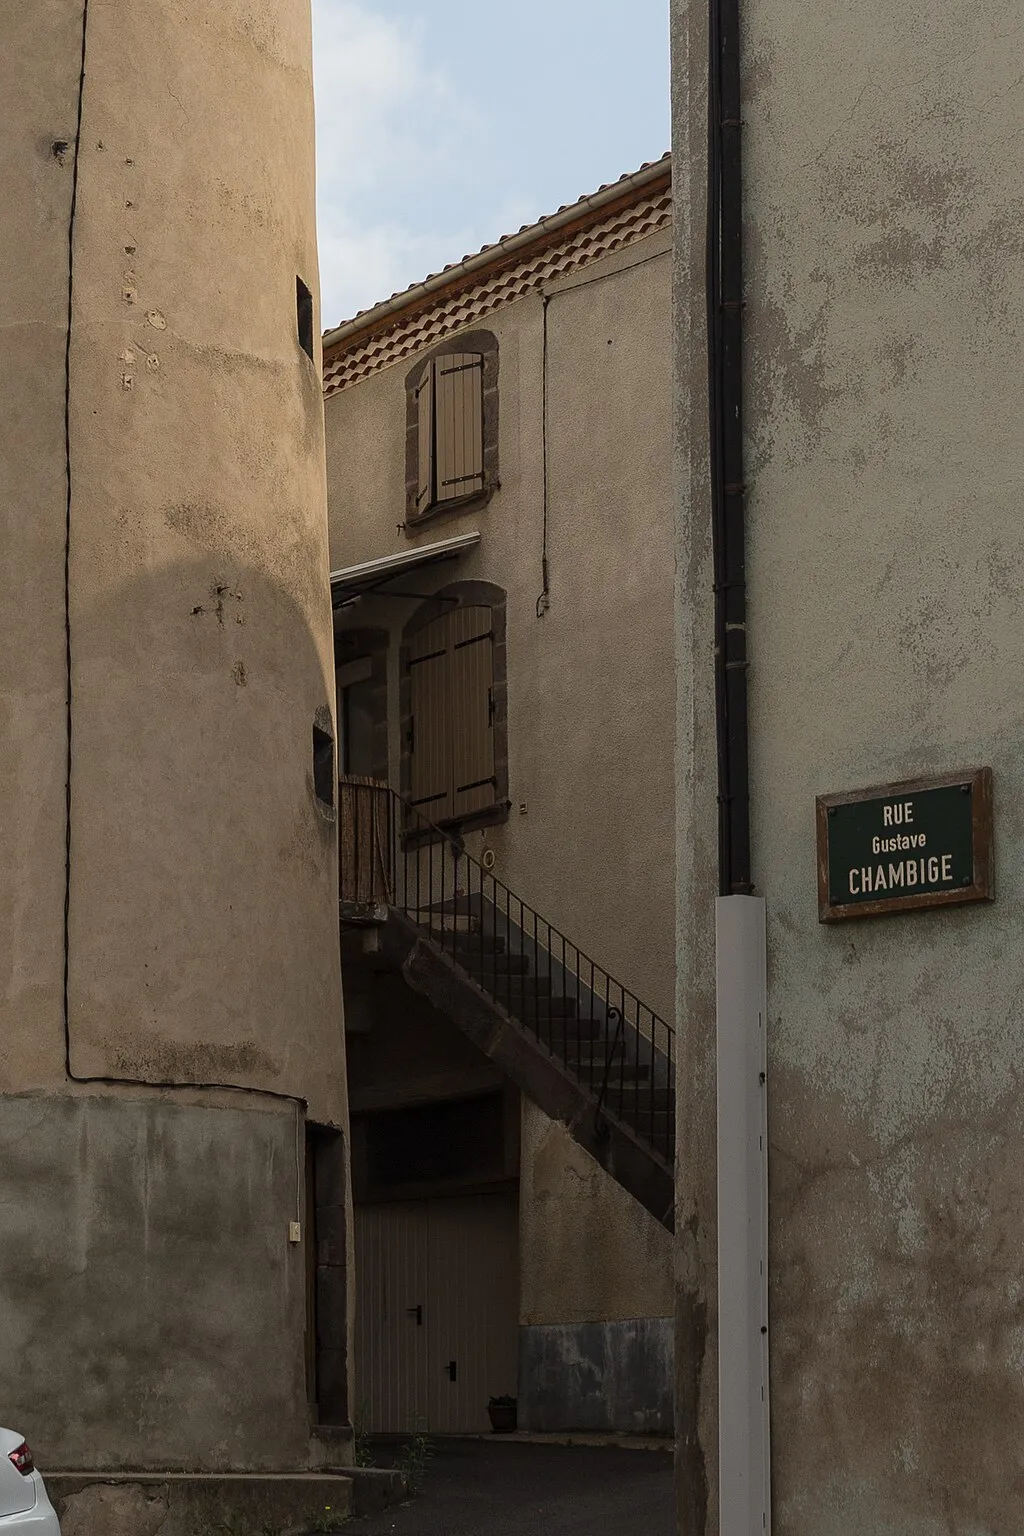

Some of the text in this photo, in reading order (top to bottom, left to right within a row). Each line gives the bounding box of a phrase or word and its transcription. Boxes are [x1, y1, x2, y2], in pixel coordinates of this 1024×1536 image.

[883, 802, 914, 827] RUE
[872, 833, 926, 854] Gustave
[849, 854, 954, 895] CHAMBIGE
